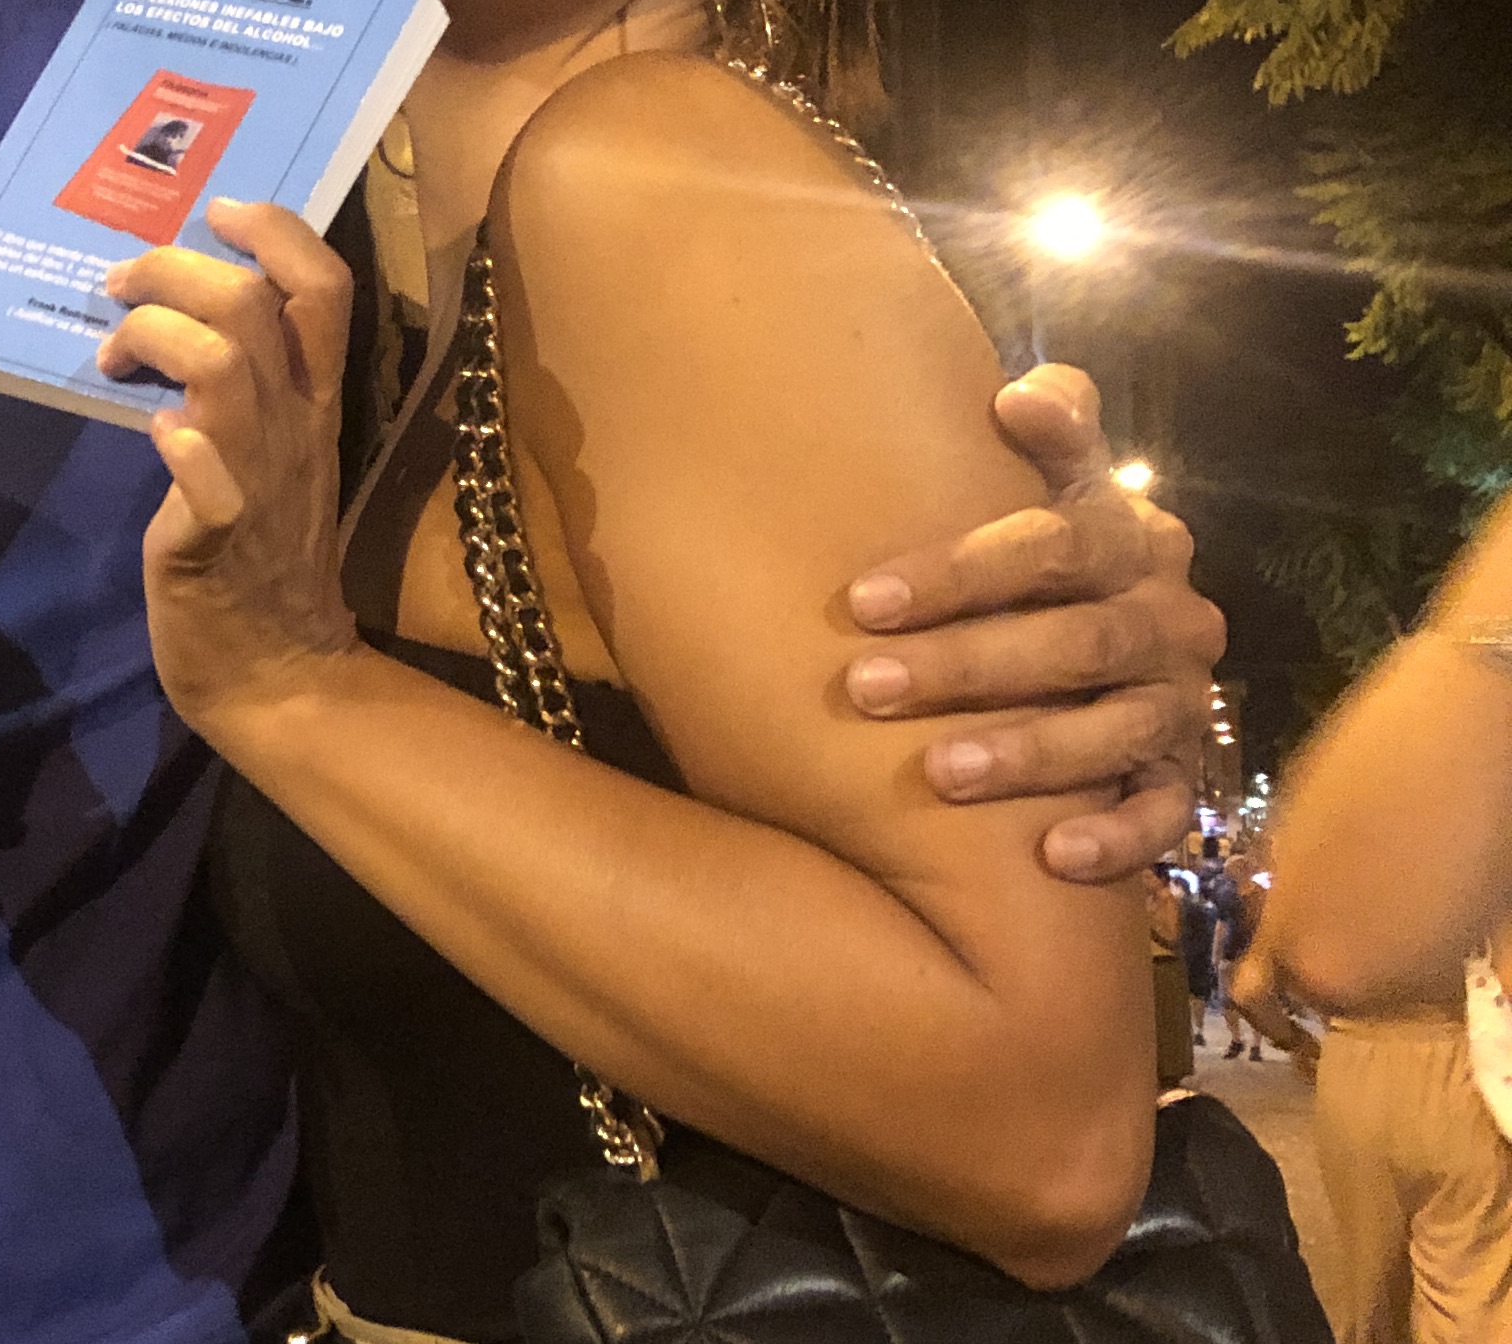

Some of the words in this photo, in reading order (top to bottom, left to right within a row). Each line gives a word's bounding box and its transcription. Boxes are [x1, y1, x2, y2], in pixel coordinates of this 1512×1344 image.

[114, 0, 144, 19] LOS
[144, 5, 210, 30] EFECTOS
[211, 18, 240, 36] DEL
[220, 2, 302, 30] INEFABLES
[302, 18, 346, 39] BAJO
